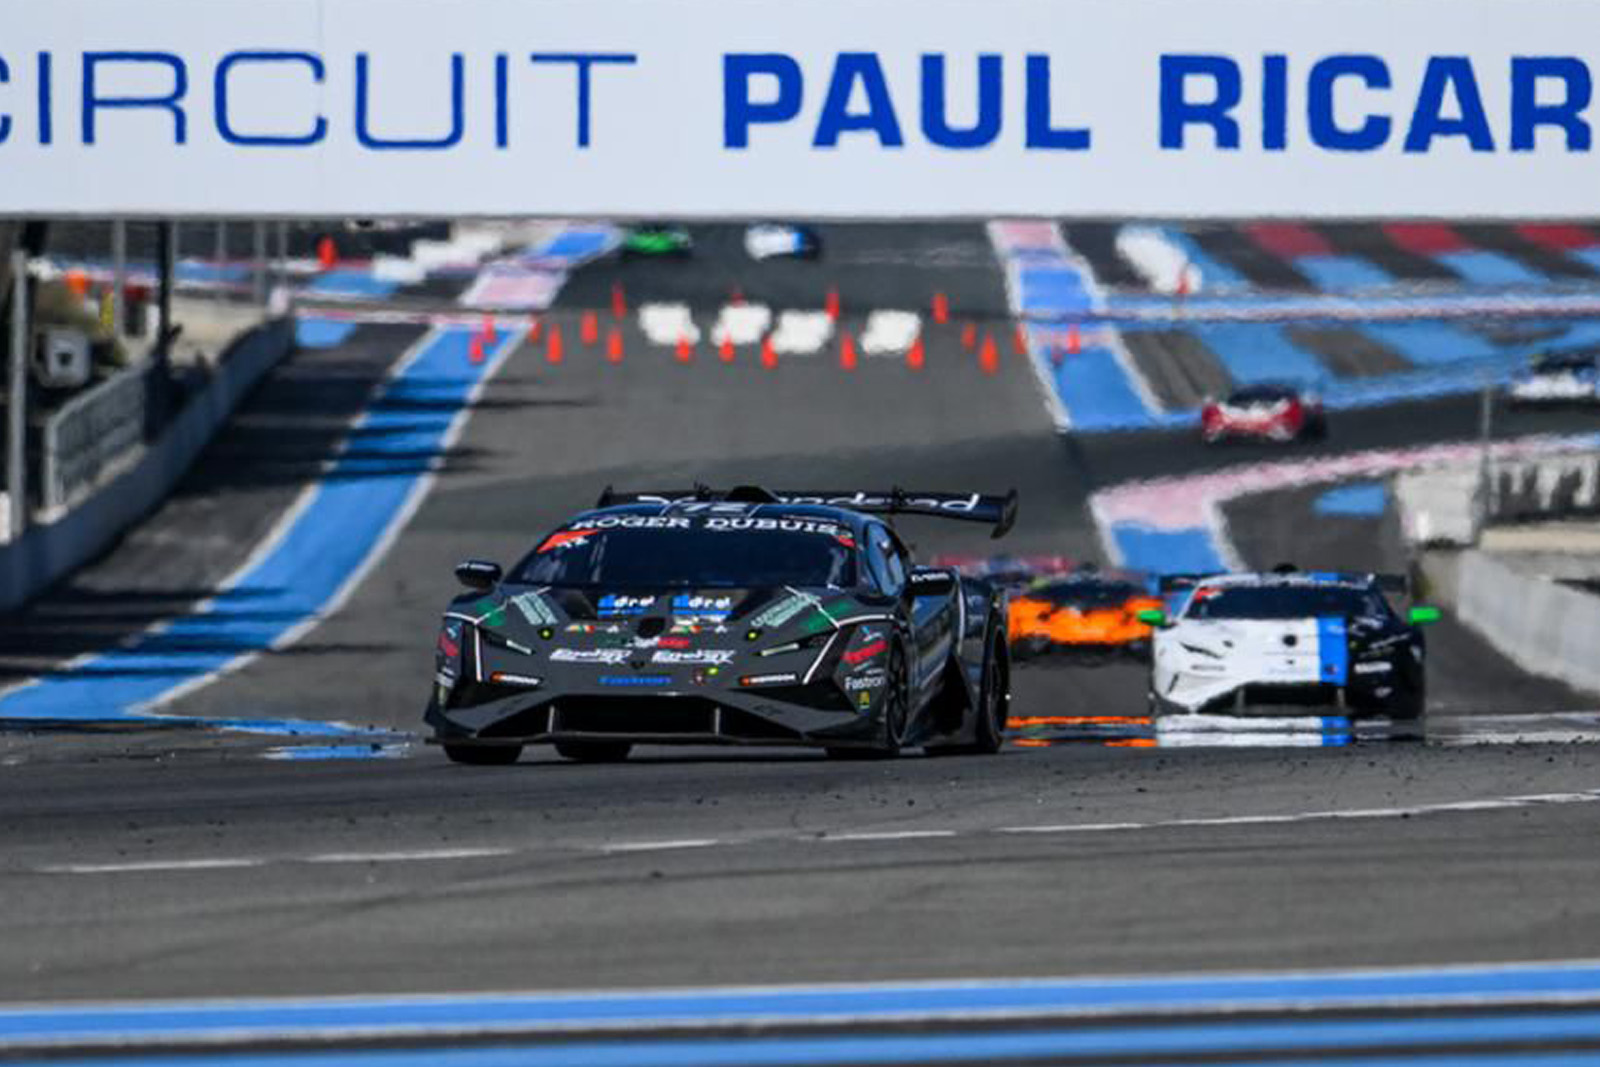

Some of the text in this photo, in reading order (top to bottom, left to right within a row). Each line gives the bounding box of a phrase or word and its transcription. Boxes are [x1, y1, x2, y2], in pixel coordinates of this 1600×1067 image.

[0, 50, 1593, 154] IRCUIT PAUL RICAR
[571, 516, 690, 530] ROGER
[703, 517, 840, 534] DUBUIS
